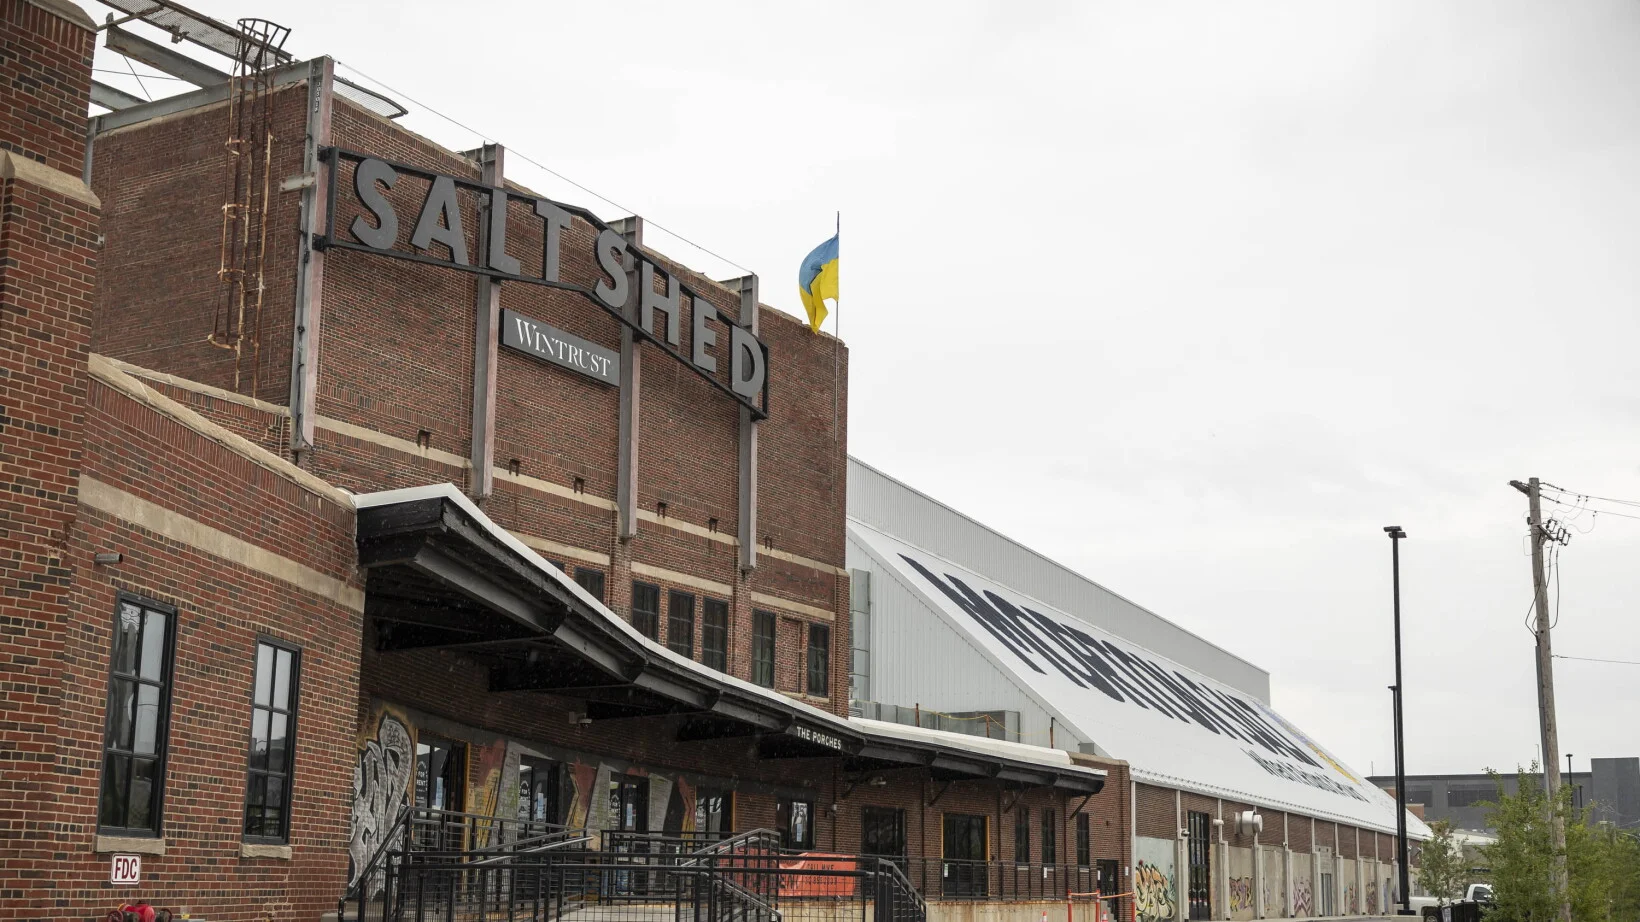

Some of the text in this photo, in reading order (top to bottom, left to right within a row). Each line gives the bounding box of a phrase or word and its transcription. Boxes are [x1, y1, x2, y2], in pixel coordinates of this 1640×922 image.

[349, 157, 766, 399] SALT SHED
[515, 318, 611, 377] WINTRUST
[896, 552, 1324, 770] MORTON SALT
[796, 726, 842, 750] THE PORCHES
[114, 857, 138, 880] FDC
